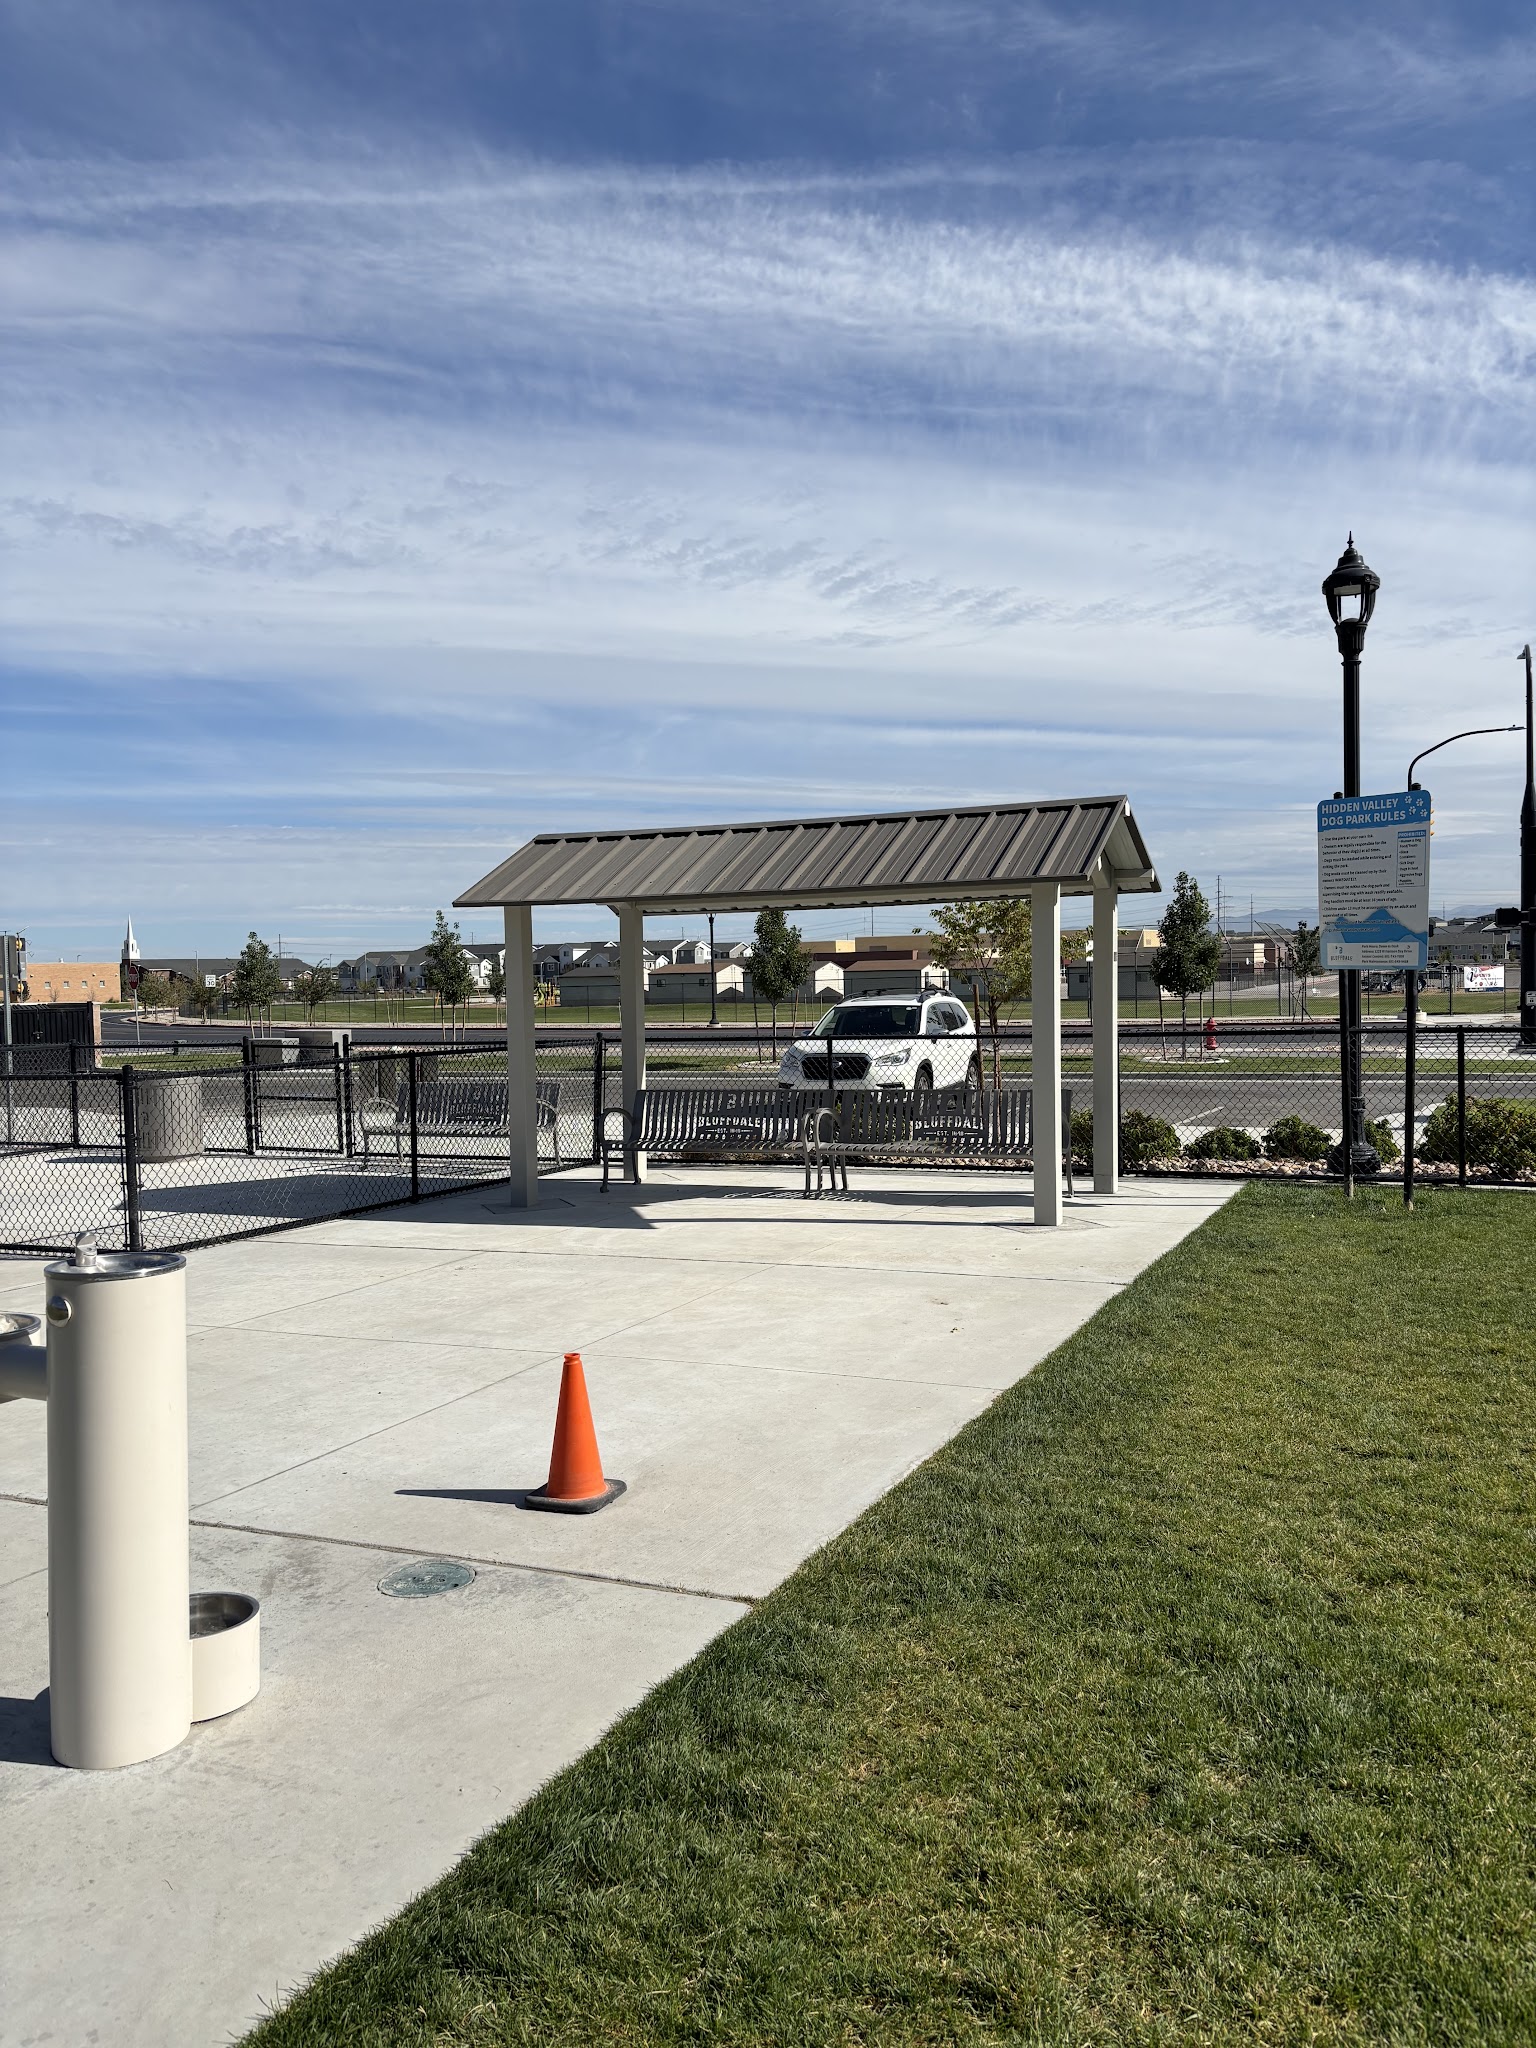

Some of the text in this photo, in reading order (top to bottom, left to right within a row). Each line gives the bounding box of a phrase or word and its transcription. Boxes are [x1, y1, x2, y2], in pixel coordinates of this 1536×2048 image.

[1322, 798, 1398, 814] HIDDEN VALLEY
[1322, 810, 1406, 826] DOG PARK RULES
[698, 1116, 760, 1127] BLUFFDALE
[915, 1116, 984, 1130] BLUFFDALE
